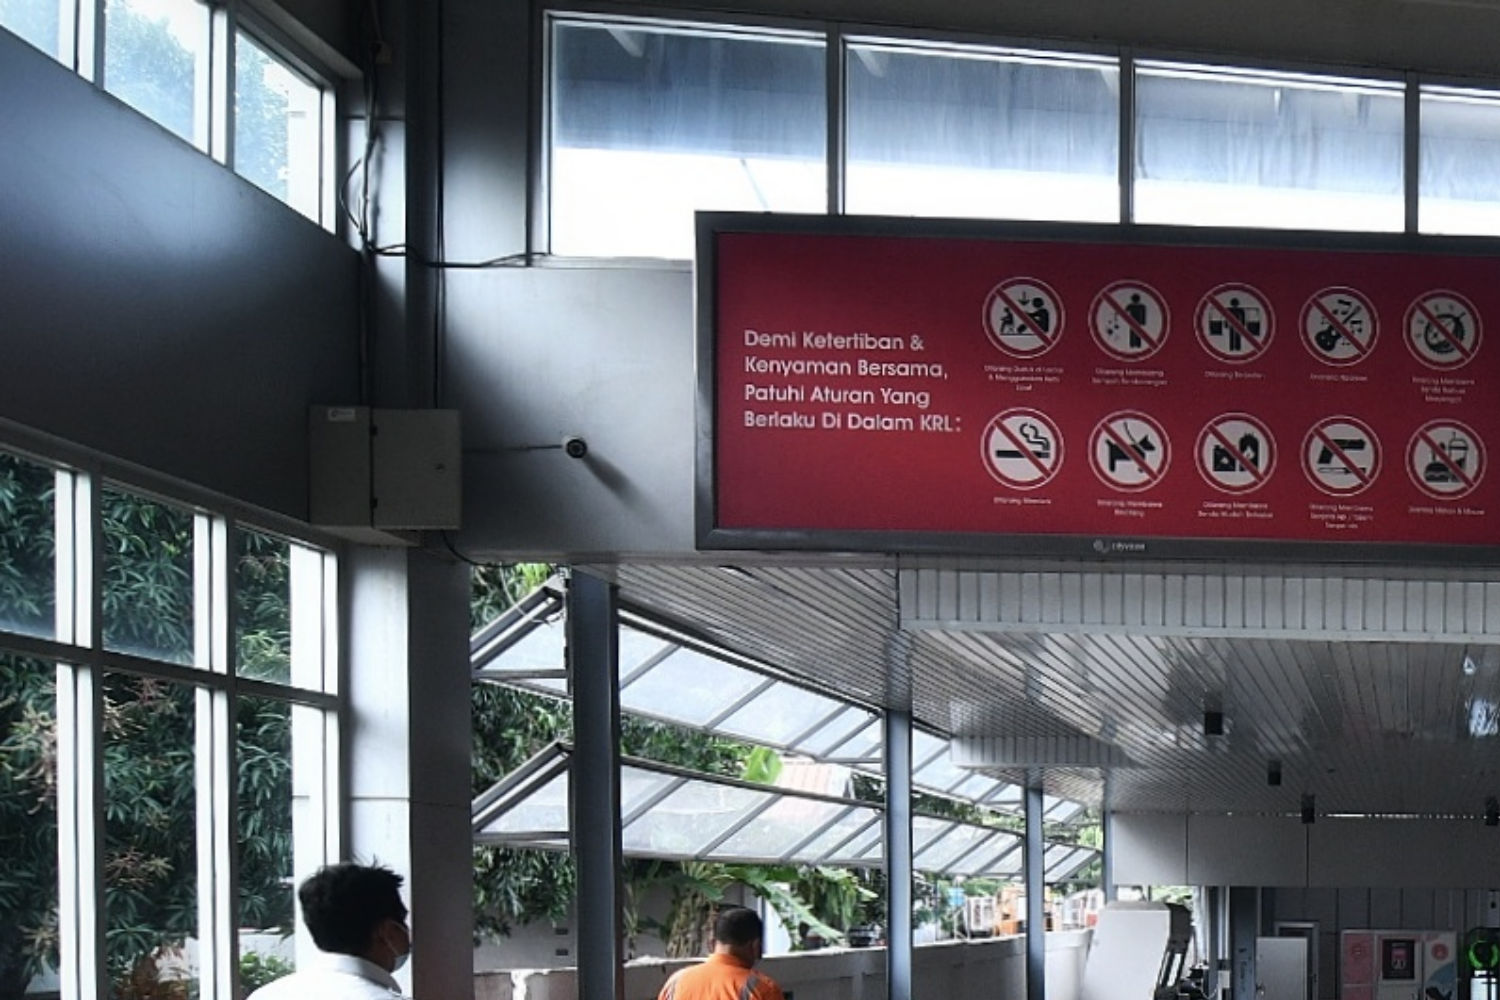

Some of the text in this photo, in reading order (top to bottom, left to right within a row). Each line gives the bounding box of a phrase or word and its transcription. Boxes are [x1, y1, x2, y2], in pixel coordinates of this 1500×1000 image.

[744, 330, 924, 350] Demi Ketertiban &
[744, 356, 948, 380] Kenyaman Bersama,
[744, 383, 930, 408] Patuhi Aturan Yang
[744, 411, 815, 428] Berlaku
[822, 412, 842, 429] Di
[848, 414, 913, 431] Dalam
